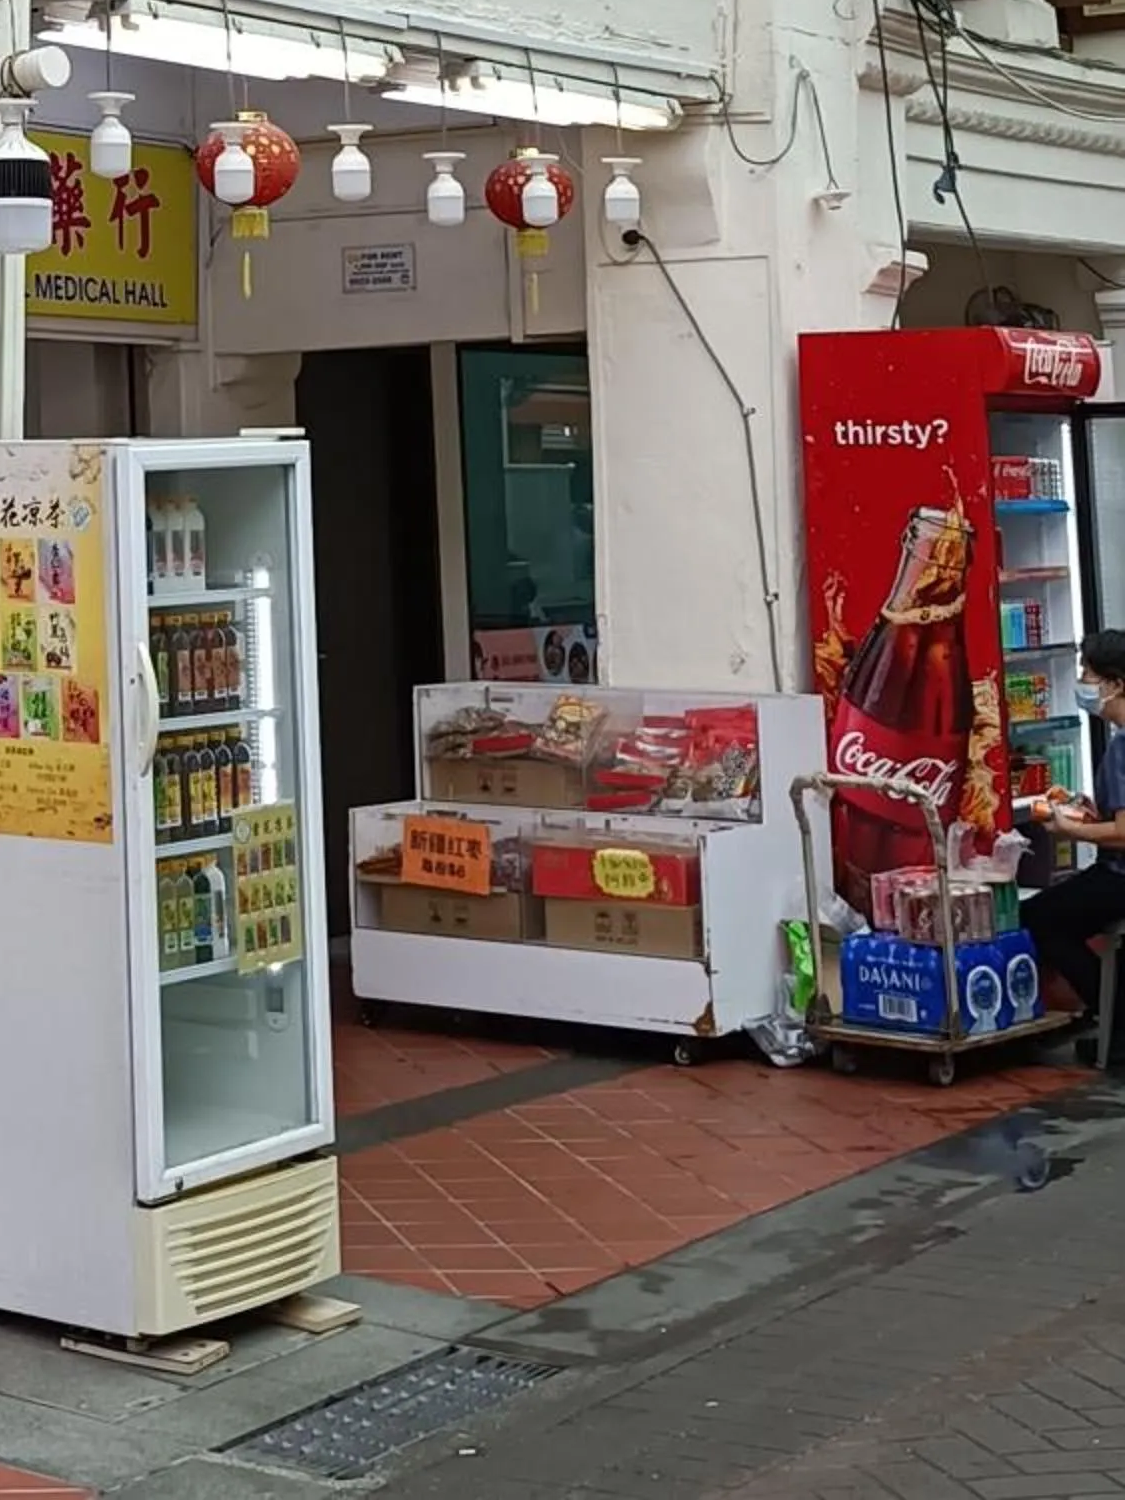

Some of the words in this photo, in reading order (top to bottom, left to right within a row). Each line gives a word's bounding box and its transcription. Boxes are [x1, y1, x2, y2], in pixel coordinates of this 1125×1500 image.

[34, 273, 121, 304] MEDICAL
[124, 280, 168, 308] HALL
[834, 418, 949, 449] thirsty?
[835, 731, 959, 807] Coca-Cola
[410, 828, 483, 860] 新疆红枣
[858, 964, 921, 992] DASANI
